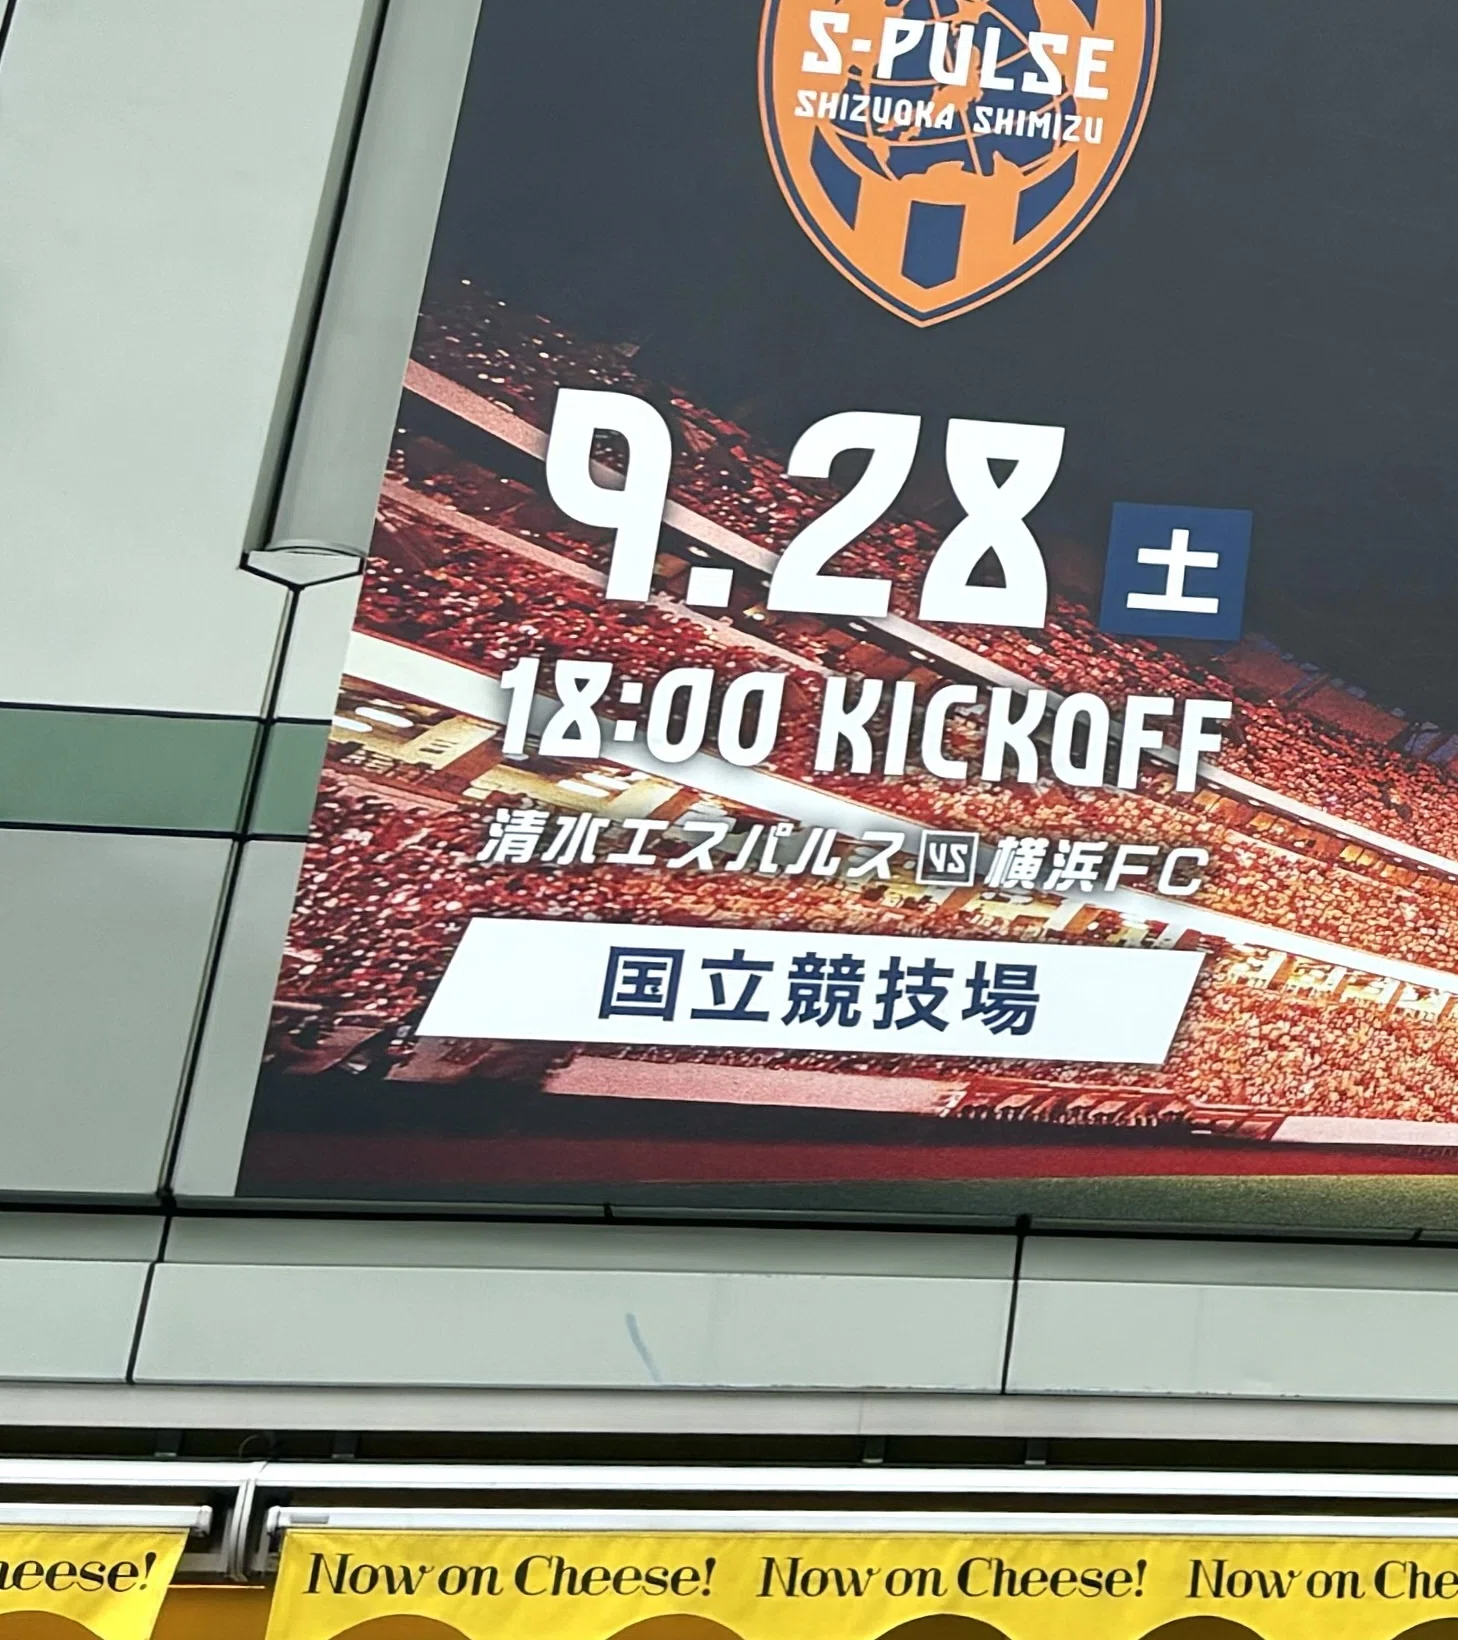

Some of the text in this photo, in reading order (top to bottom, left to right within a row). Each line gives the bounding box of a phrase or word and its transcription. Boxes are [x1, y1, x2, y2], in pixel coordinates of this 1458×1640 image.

[801, 9, 1115, 102] S-PULSE
[794, 89, 1104, 145] SHIZUOKA SHIMIZU
[545, 388, 1220, 629] 9.28 土
[499, 657, 1233, 793] 18:00 KICKOFF
[477, 807, 905, 884] 清水エスパルス
[984, 836, 1209, 897] 横浜FC
[597, 944, 1042, 1037] 国立競技場
[302, 1552, 717, 1597] Now on Cheese!
[756, 1556, 1148, 1598] Now on Cheese!
[1185, 1558, 1303, 1599] Now
[1305, 1569, 1366, 1599] on
